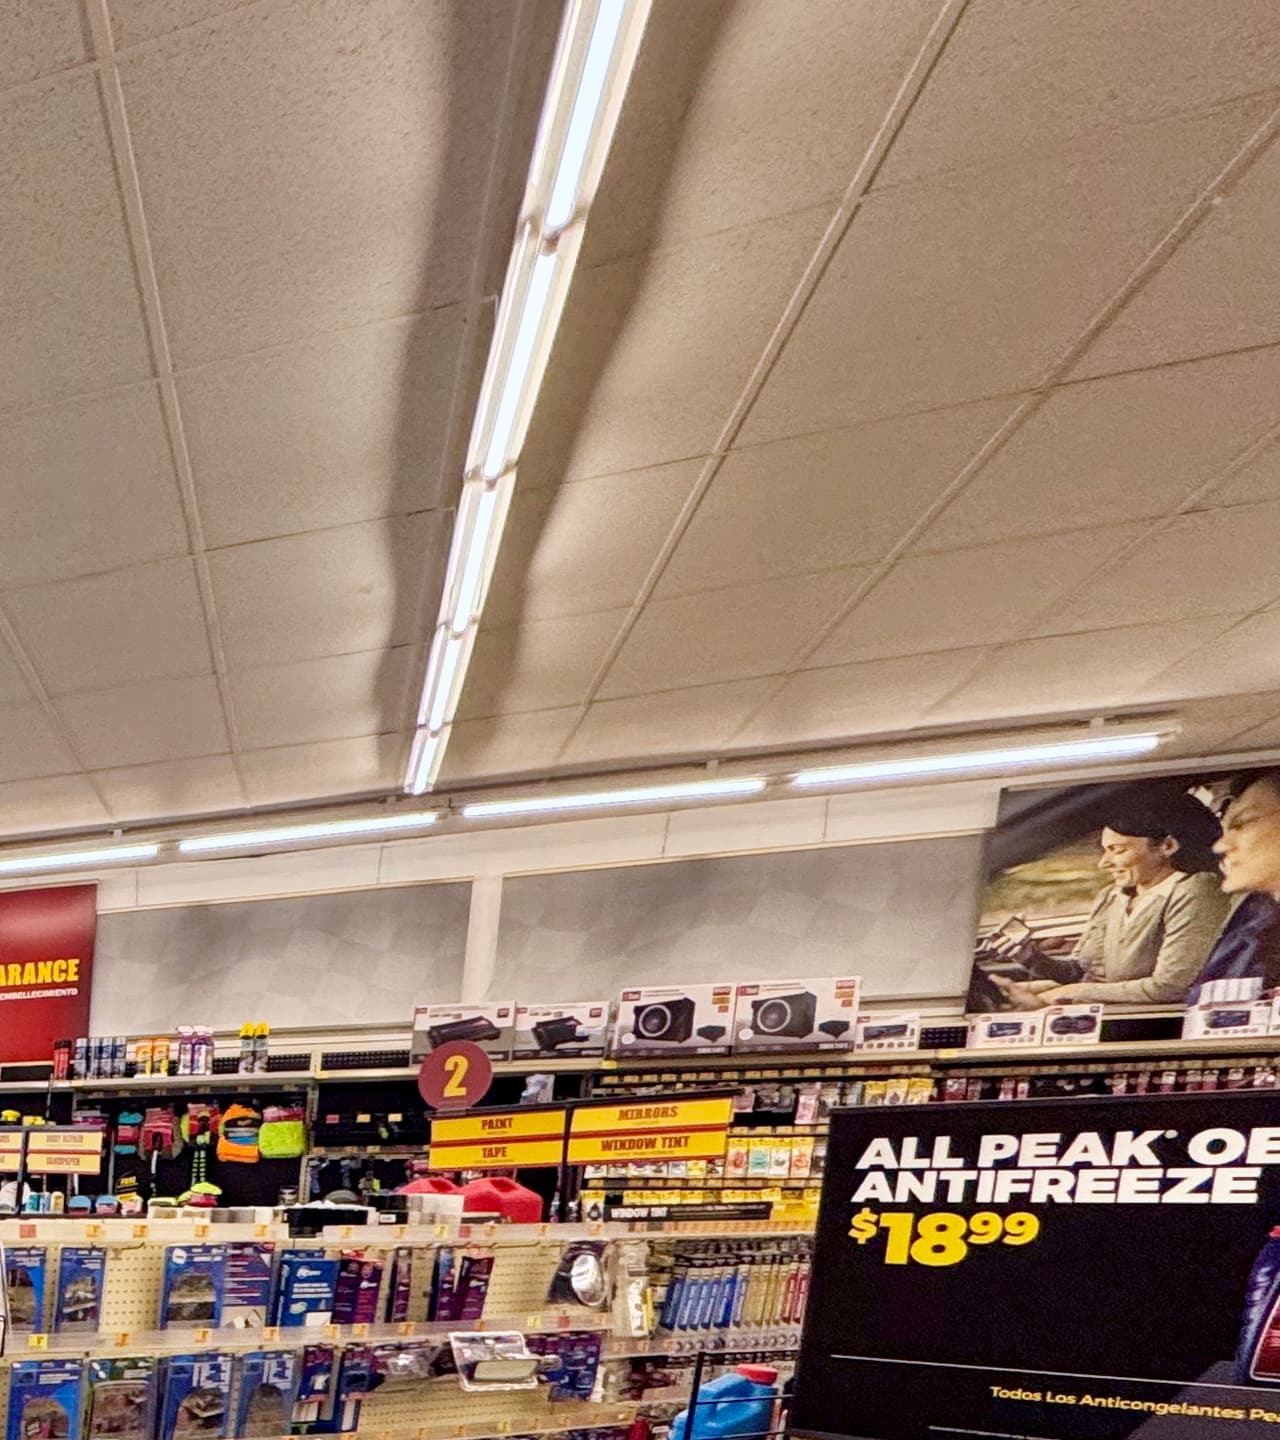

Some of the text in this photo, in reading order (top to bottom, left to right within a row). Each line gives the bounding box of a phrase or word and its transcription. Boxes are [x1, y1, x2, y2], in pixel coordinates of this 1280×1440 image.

[443, 1055, 468, 1098] 2
[481, 1118, 513, 1131] PAINT
[618, 1106, 678, 1121] MIRRORS
[482, 1147, 507, 1158] TAPE
[601, 1136, 690, 1151] WINDOW TINT
[855, 1136, 964, 1170] ALL
[977, 1130, 1167, 1169] PEAK
[850, 1166, 1263, 1205] ANTIFREEZE
[990, 1385, 1041, 1403] Todos
[1046, 1391, 1077, 1404] Los
[1080, 1393, 1246, 1421] Anticongelantes
